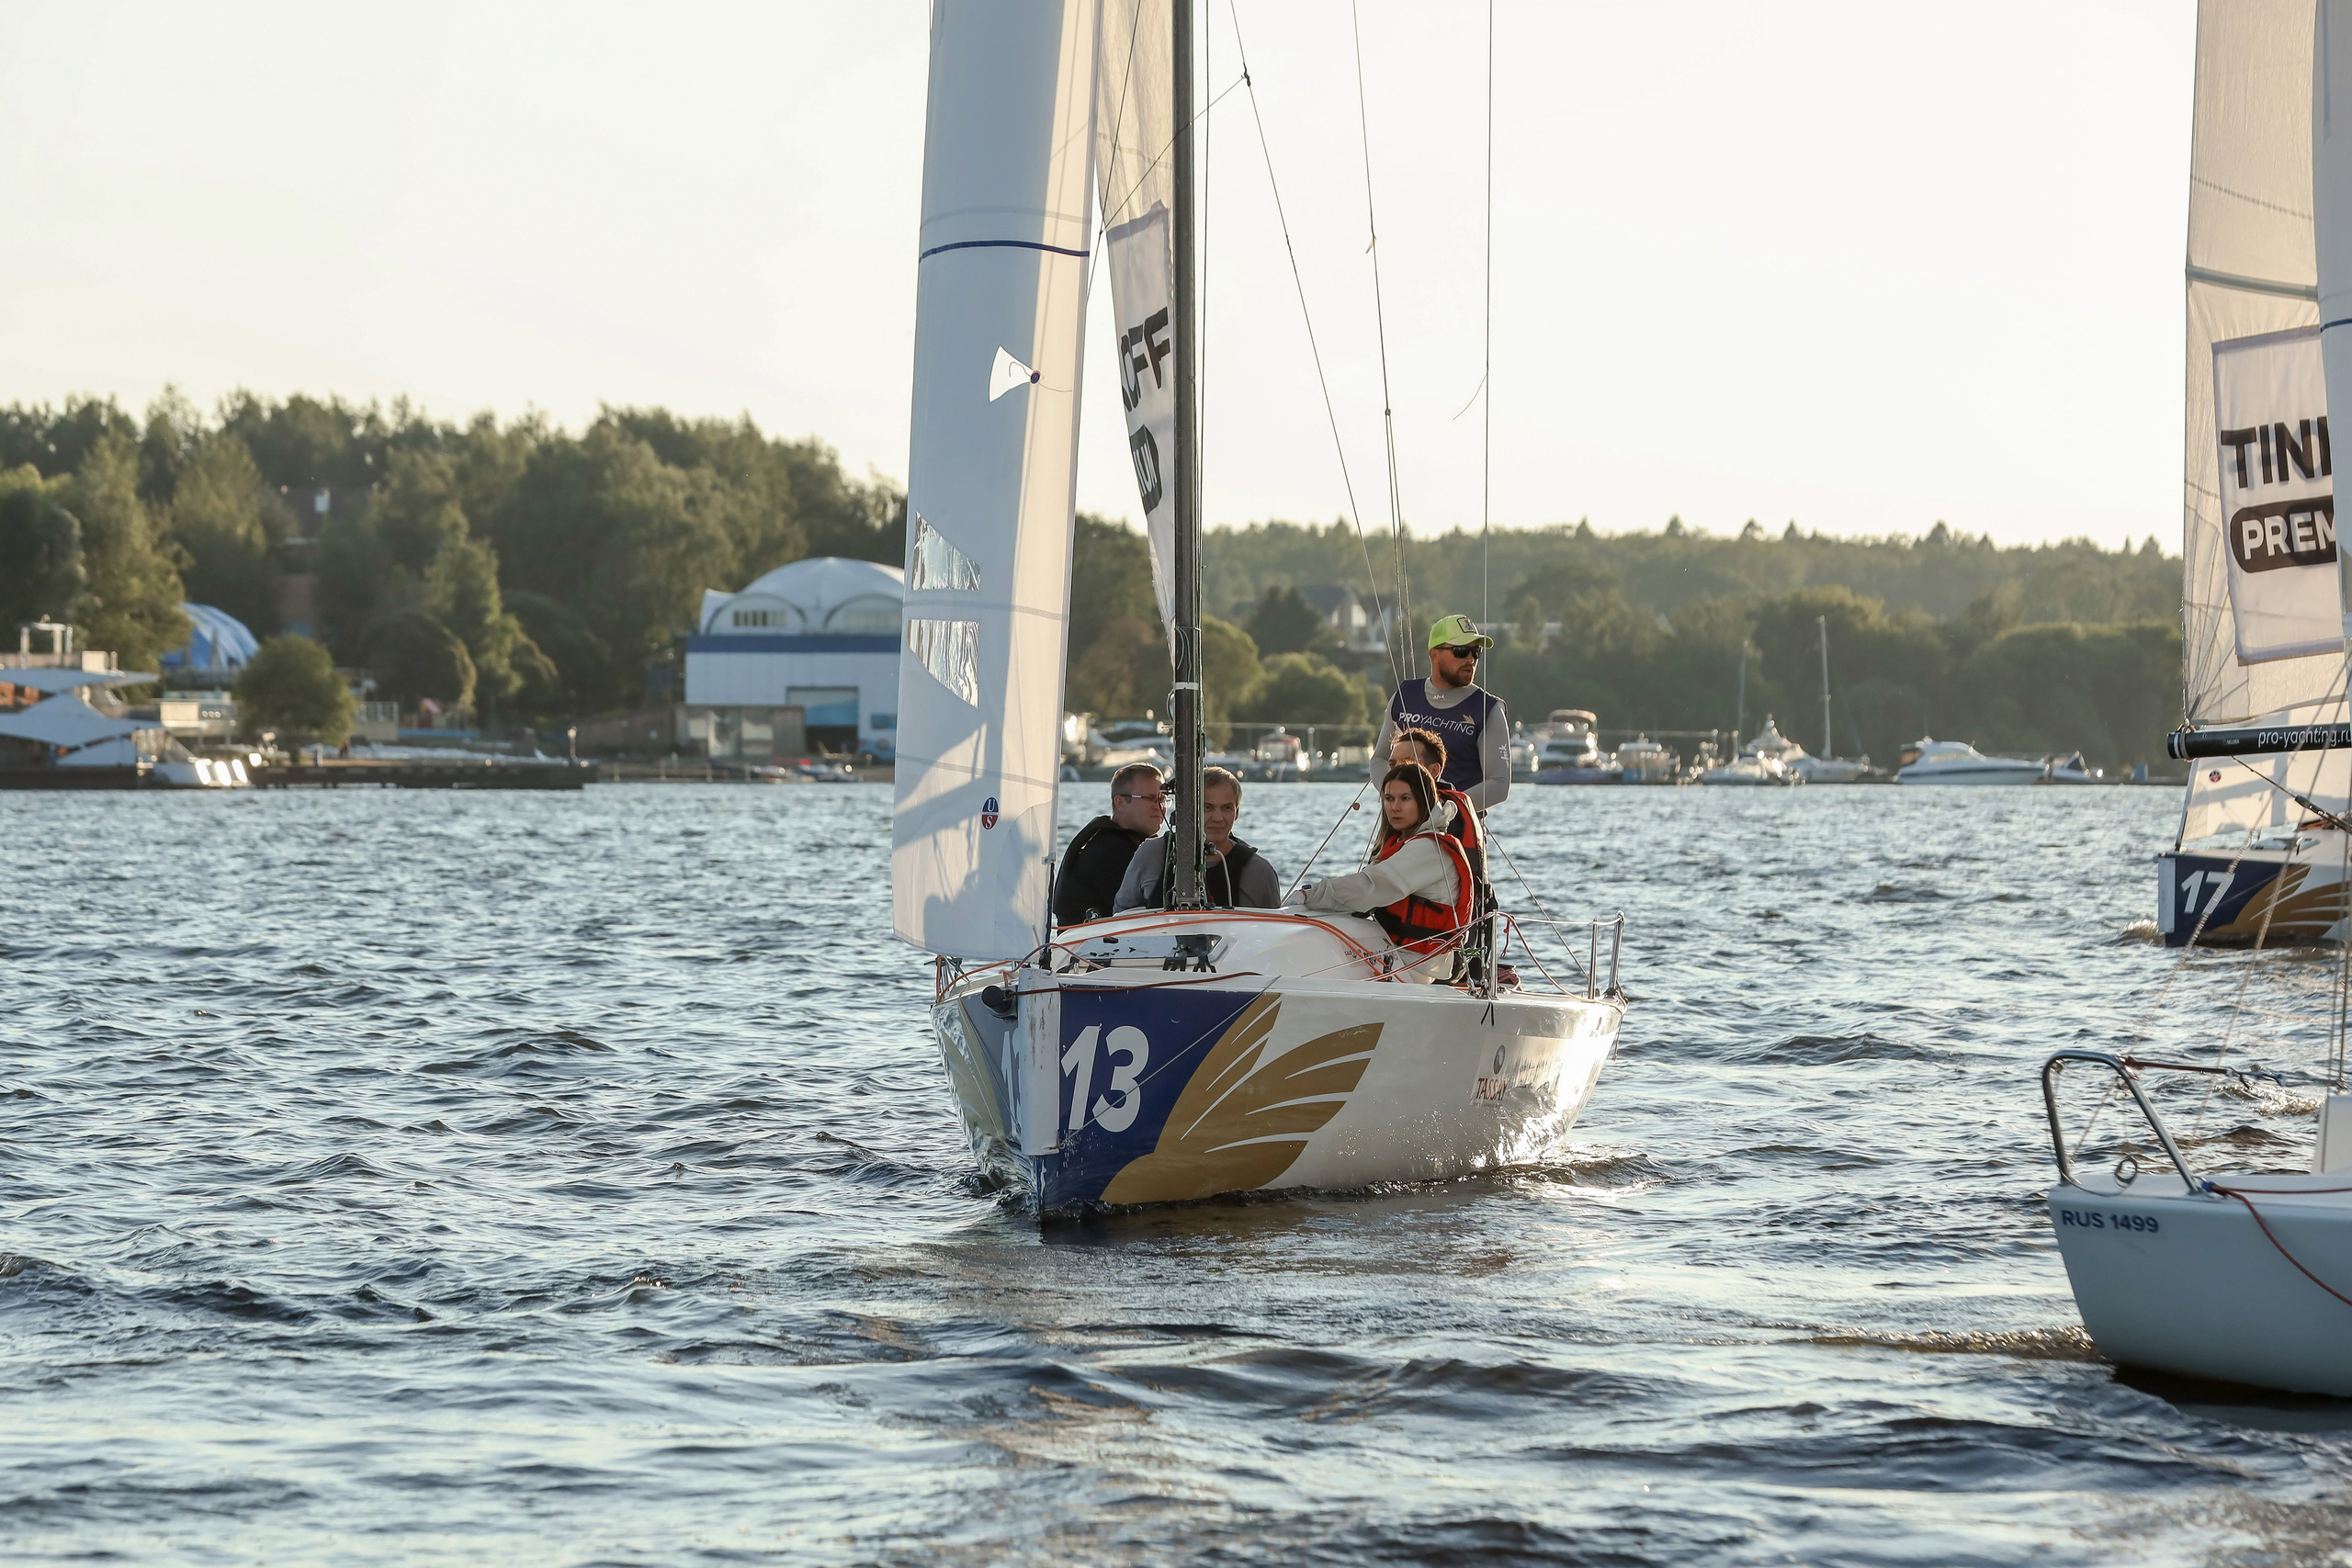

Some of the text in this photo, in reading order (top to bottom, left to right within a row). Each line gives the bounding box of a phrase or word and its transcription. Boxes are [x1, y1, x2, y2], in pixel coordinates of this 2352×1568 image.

[1121, 306, 1170, 412] OFF
[1398, 712, 1475, 736] PROYACHTING
[2257, 726, 2352, 749] pro-yachting.ru
[2181, 870, 2235, 915] 17
[1060, 1024, 1149, 1133] 13
[2061, 1210, 2159, 1233] RUS 1499
